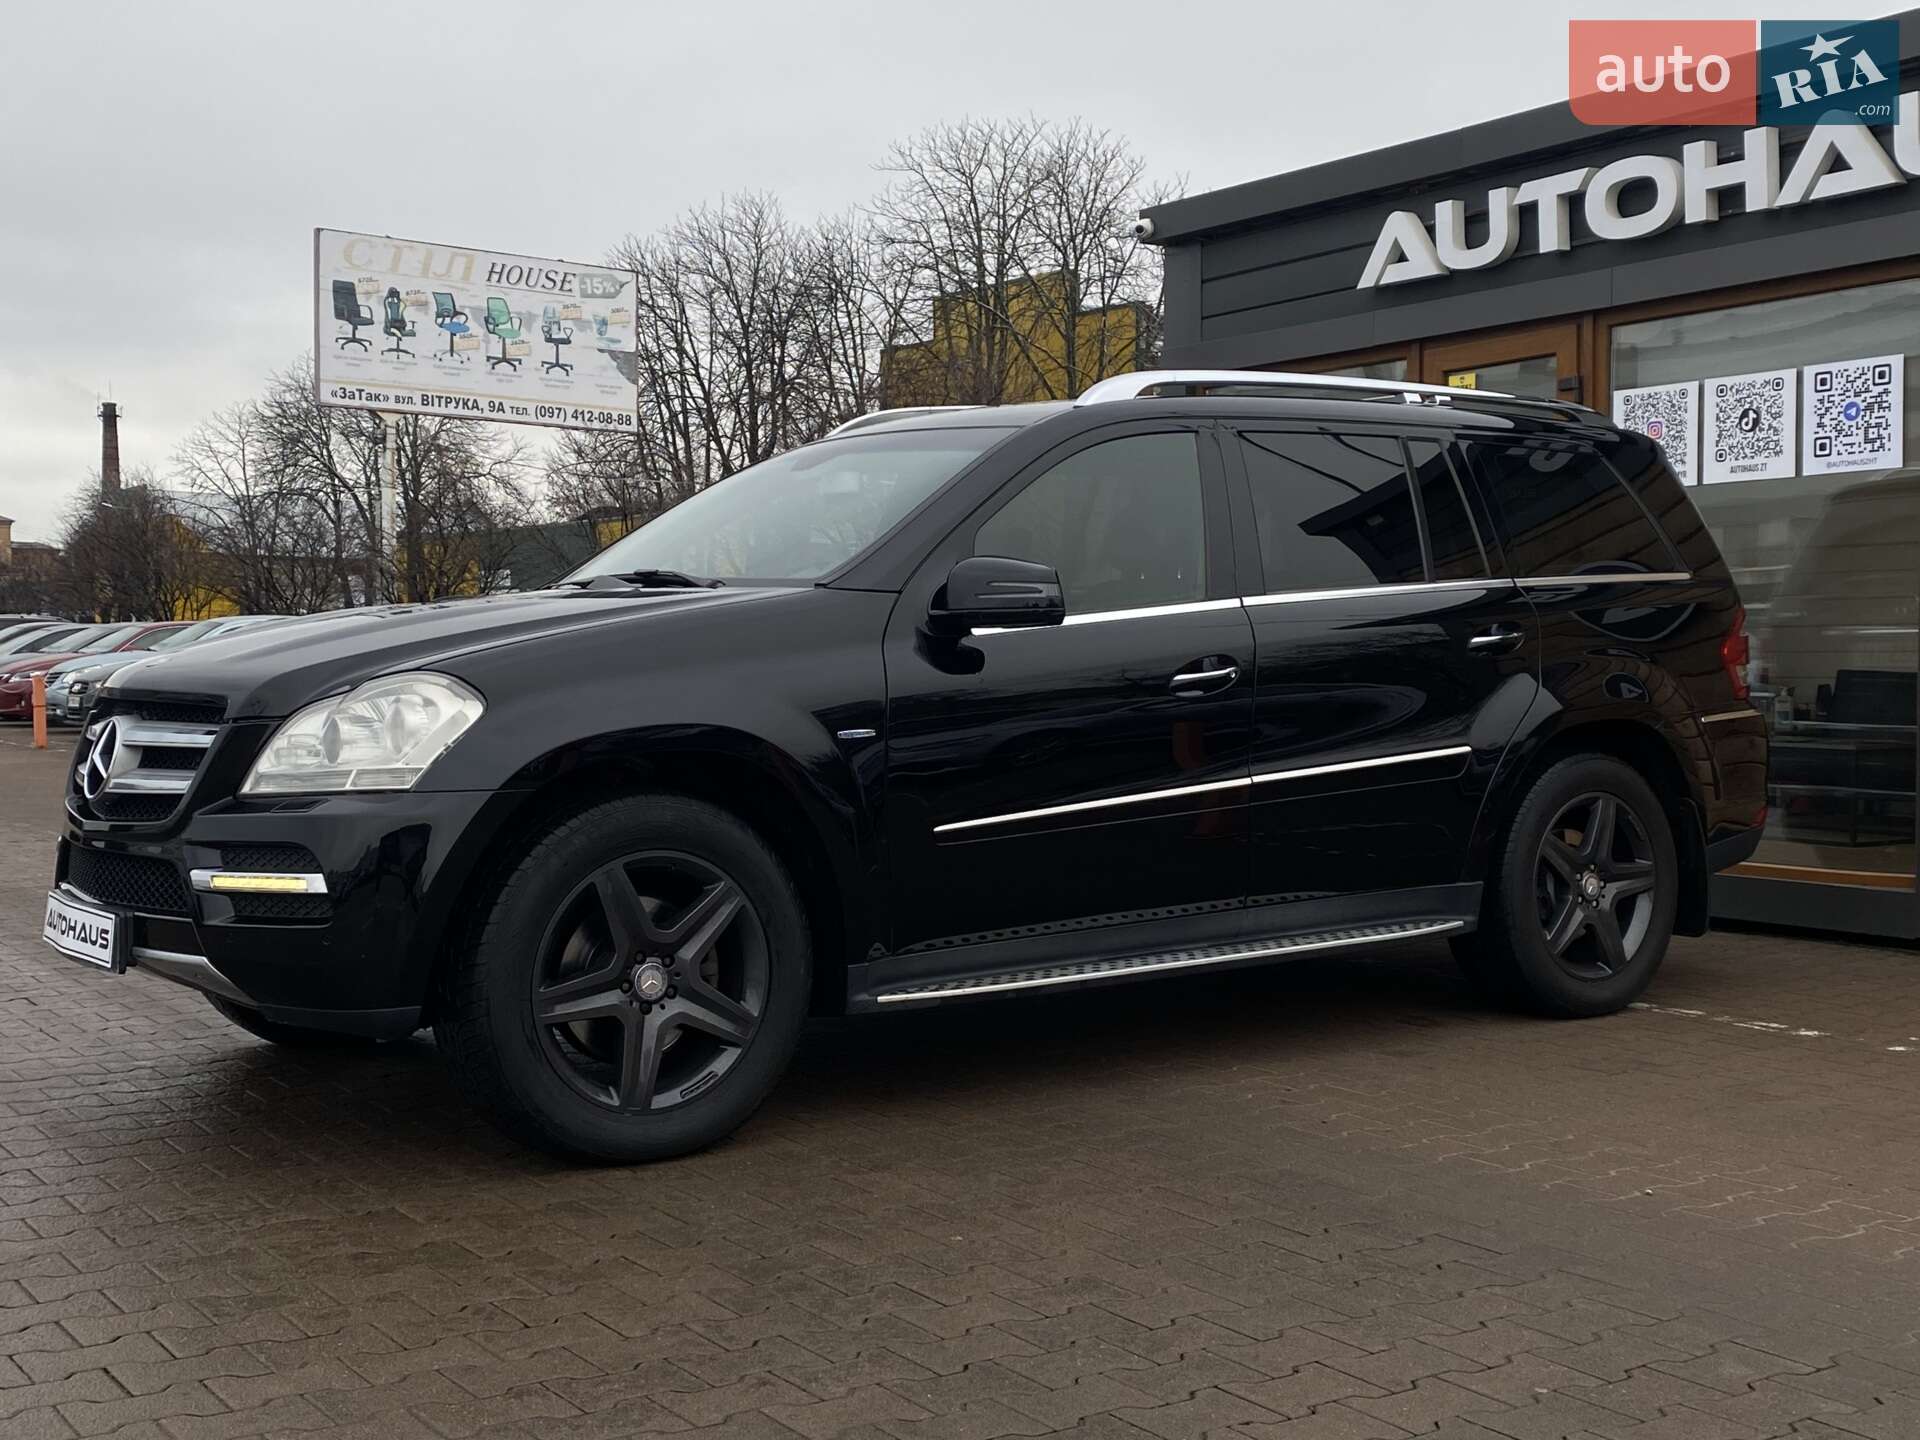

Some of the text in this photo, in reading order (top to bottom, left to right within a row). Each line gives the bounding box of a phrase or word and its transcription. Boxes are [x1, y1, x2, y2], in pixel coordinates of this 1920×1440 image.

[1357, 91, 1920, 289] AUTOHA
[486, 262, 577, 294] HOUSE
[421, 393, 484, 414] ВІТРУКА,
[535, 405, 567, 422] (097)
[571, 409, 632, 426] 412-08-88
[1729, 464, 1759, 473] AUTOHAUS
[46, 908, 109, 950] AUTOHAUS
